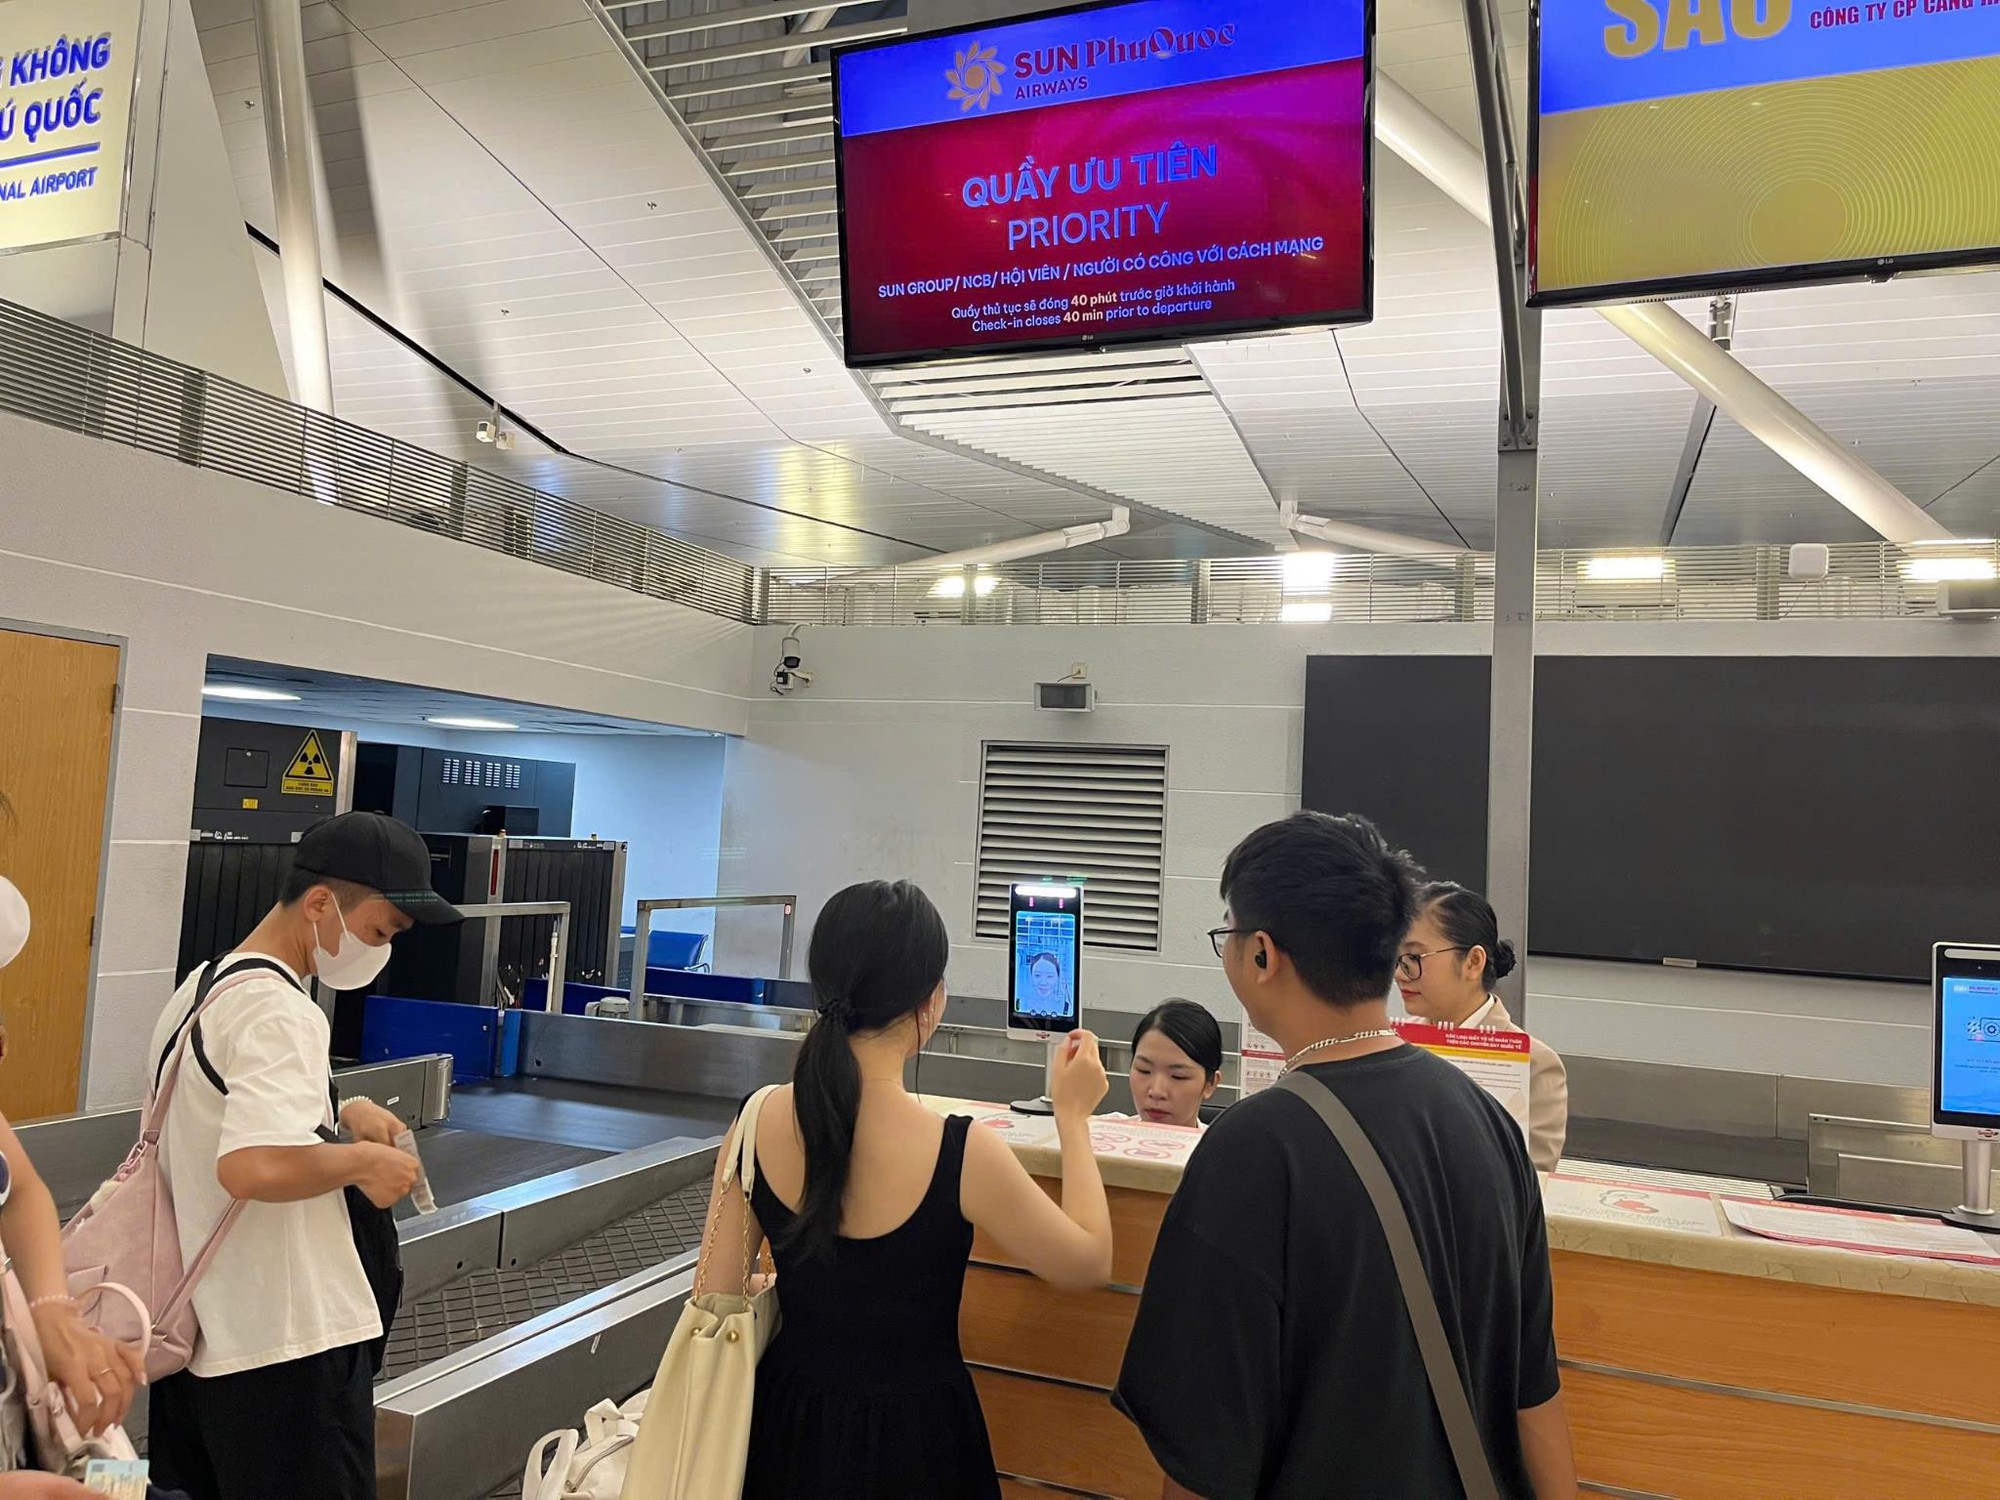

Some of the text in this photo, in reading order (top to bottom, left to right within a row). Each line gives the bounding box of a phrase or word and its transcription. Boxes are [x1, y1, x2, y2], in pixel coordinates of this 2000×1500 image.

[1810, 6, 1859, 29] CÔNG
[1865, 2, 1887, 22] TY
[1893, 0, 1917, 18] CP
[10, 33, 110, 87] KHÔNG
[1015, 44, 1078, 79] SUN
[1015, 76, 1088, 100] AIRWAYS
[24, 78, 103, 143] QUỐC
[30, 166, 98, 196] AIRPORT
[962, 140, 1217, 208] QUẦY ƯU TIÊN
[1008, 202, 1169, 250] PRIORITY
[878, 282, 905, 298] SUN
[1001, 266, 1025, 287] HỘI
[1028, 264, 1060, 281] VIÊN
[1073, 257, 1120, 277] NGƯỜI
[1123, 253, 1146, 271] CÓ
[1149, 249, 1194, 268] CÔNG
[1197, 243, 1224, 263] VỚI
[1227, 240, 1271, 260] CÁCH
[1275, 236, 1323, 257] MẠNG
[952, 303, 980, 319] Quầy
[1003, 301, 1021, 315] tục
[1023, 299, 1037, 312] sẽ
[1039, 296, 1069, 311] đóng
[1071, 295, 1088, 306] 40
[1090, 291, 1118, 308] phút
[1120, 286, 1152, 302] trước
[1154, 285, 1175, 301] giờ
[1176, 280, 1202, 296] khởi
[1205, 278, 1235, 293] hành
[972, 299, 1212, 332] Check-in closes 40 min prior to departure
